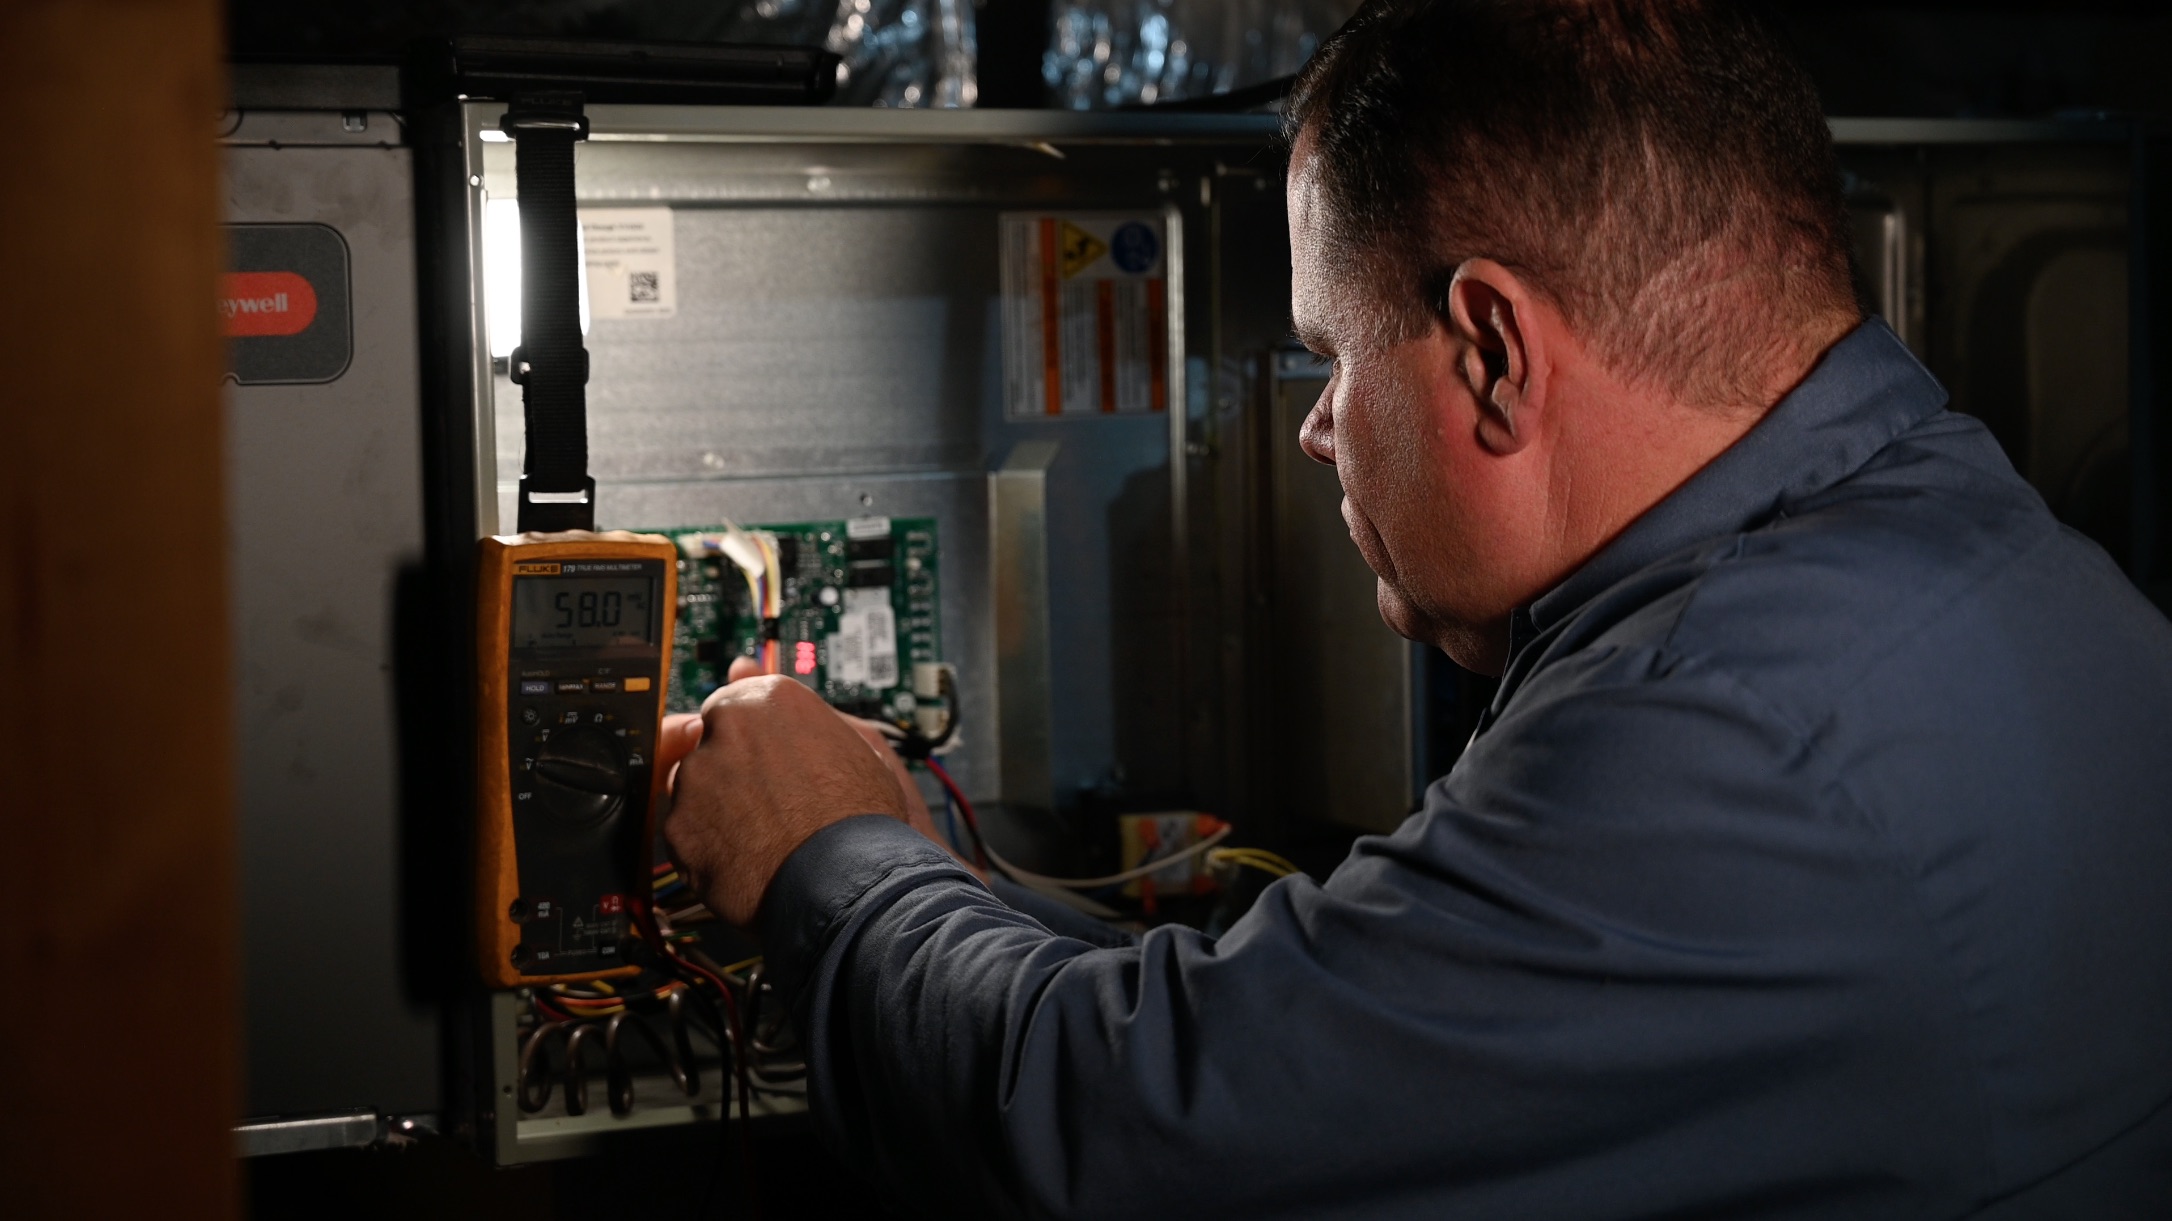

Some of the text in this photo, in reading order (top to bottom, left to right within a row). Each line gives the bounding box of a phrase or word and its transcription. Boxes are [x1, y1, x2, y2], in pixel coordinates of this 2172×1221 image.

[216, 292, 288, 319] eywell
[518, 565, 558, 573] FLUKE
[562, 564, 575, 573] 179
[607, 563, 642, 571] MULTIMETER
[556, 591, 621, 628] 58.0
[595, 682, 616, 690] RANGE
[518, 791, 532, 800] OFF
